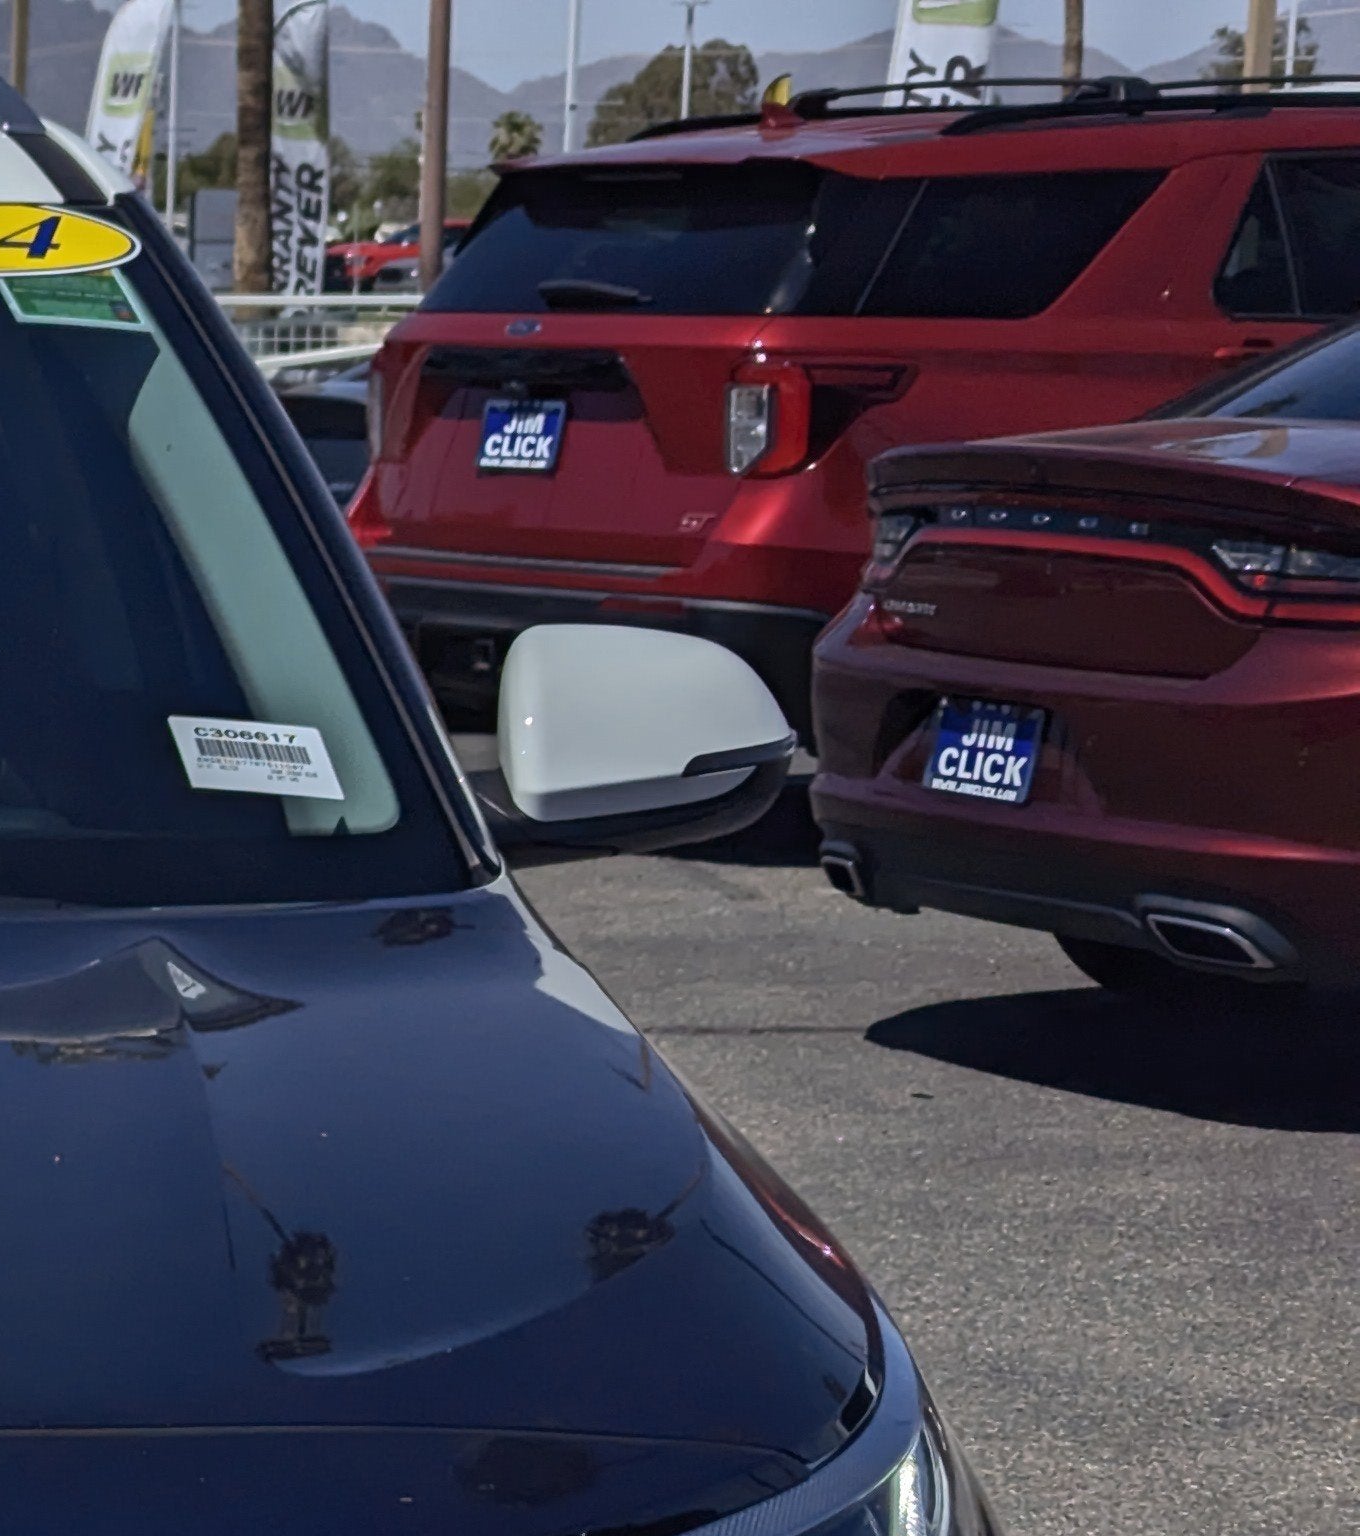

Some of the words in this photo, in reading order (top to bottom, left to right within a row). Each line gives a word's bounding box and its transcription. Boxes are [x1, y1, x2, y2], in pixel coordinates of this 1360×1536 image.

[502, 412, 546, 434] JIM
[484, 432, 554, 459] CLICK
[961, 718, 1017, 752] JIM
[937, 746, 1029, 787] CLICK
